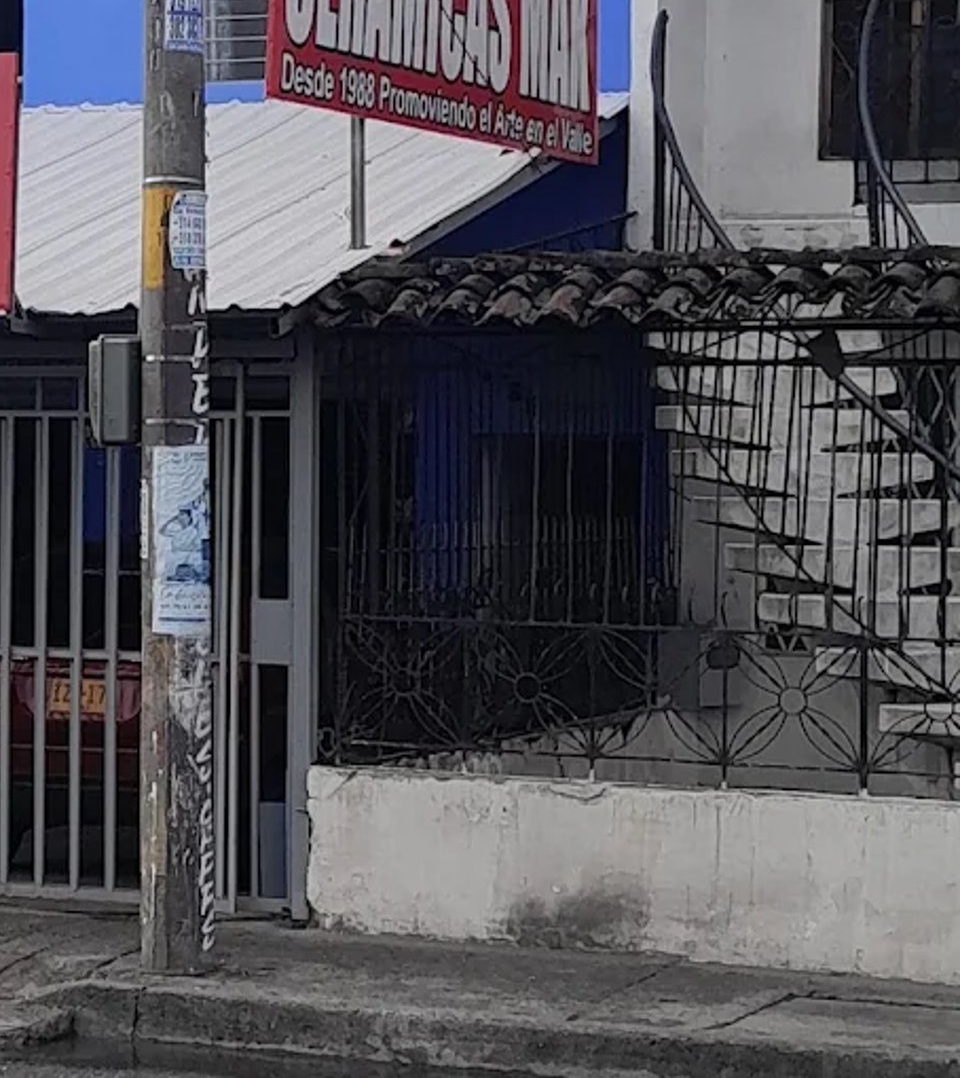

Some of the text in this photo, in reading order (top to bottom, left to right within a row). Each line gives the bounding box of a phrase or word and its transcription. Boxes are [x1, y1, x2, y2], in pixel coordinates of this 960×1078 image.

[280, 52, 334, 98] Desde
[340, 67, 376, 110] 1988
[378, 74, 476, 131] Promoviendo
[479, 99, 492, 134] el
[525, 118, 544, 145] en
[546, 116, 560, 149] el
[560, 117, 593, 156] Valle
